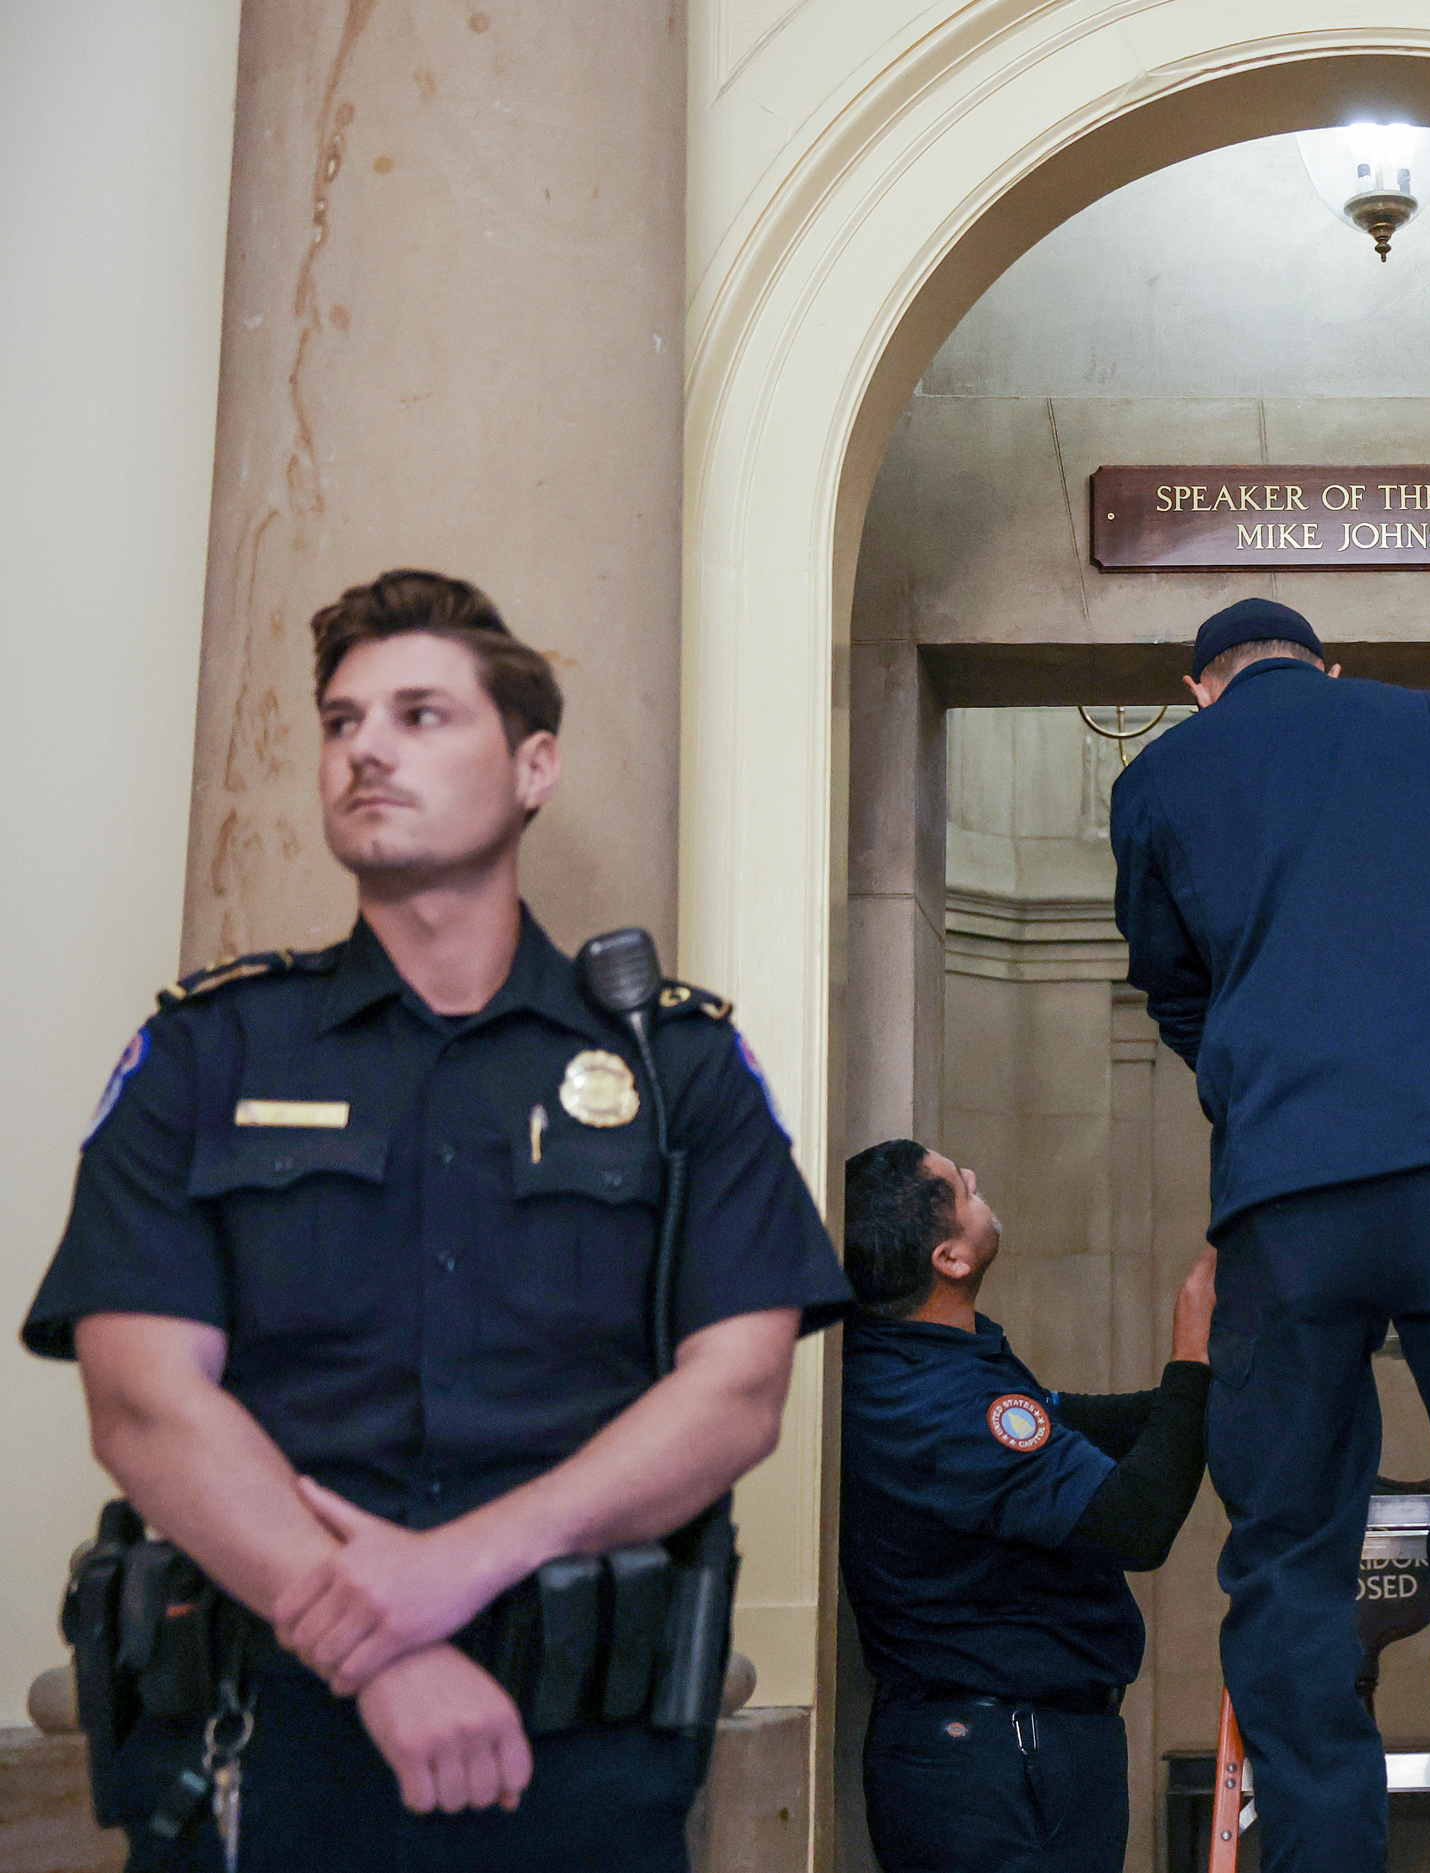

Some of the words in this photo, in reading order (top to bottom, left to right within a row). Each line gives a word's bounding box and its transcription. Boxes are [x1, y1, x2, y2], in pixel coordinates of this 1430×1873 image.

[1155, 484, 1310, 512] SPEAKER
[1320, 484, 1366, 511] OF
[1235, 522, 1323, 551] MIKE
[992, 1405, 1003, 1435] UNITED
[1002, 1399, 1035, 1412] STATES
